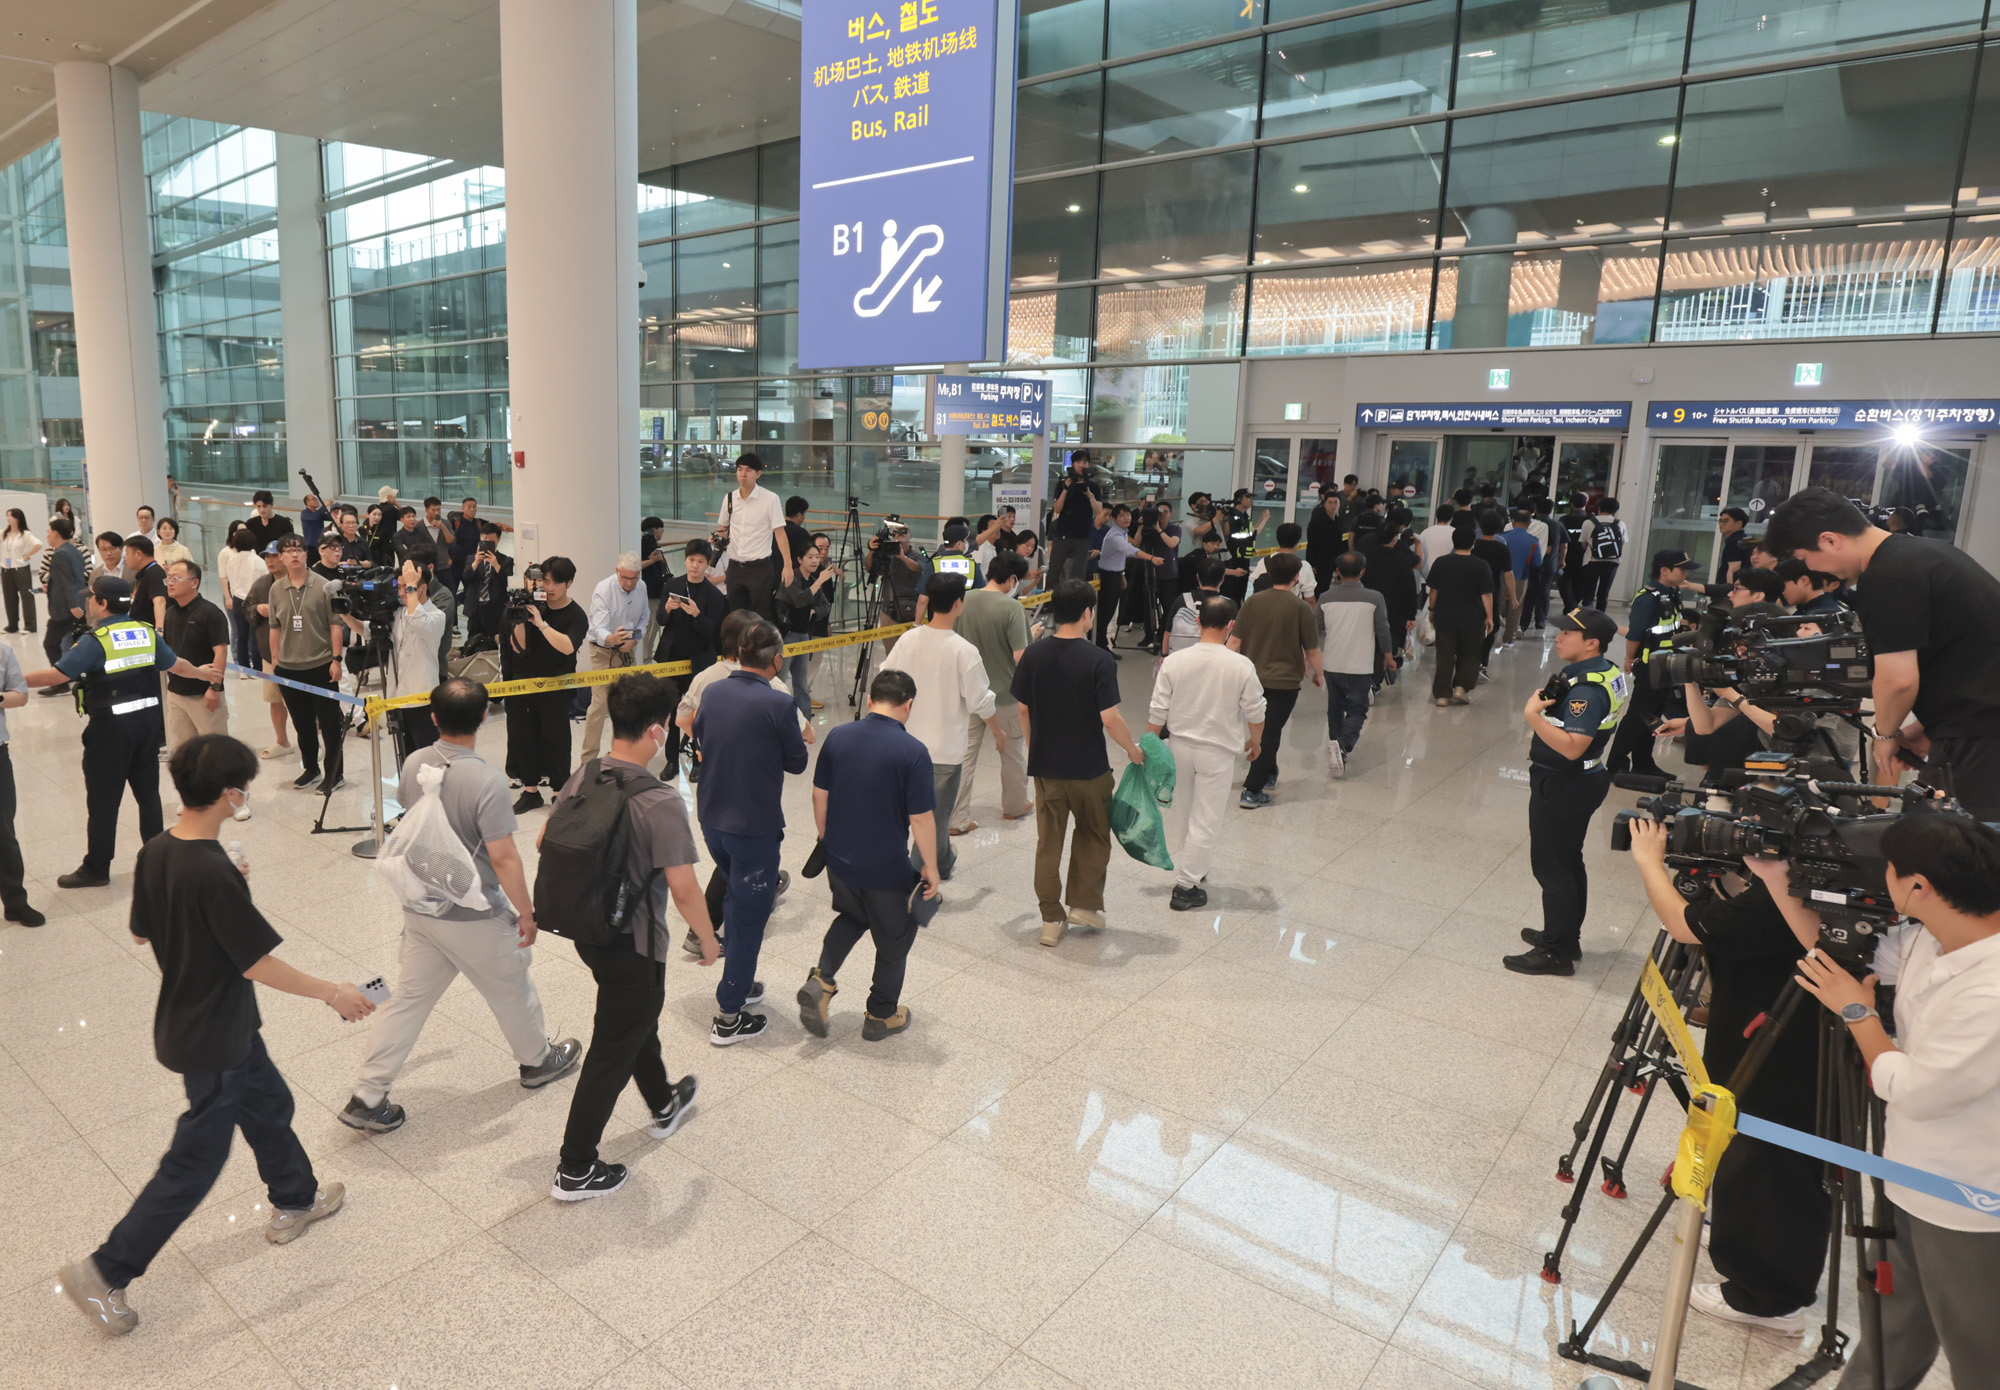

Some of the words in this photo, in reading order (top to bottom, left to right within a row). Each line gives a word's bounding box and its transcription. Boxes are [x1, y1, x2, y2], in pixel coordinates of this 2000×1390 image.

[848, 12, 891, 43] 버스,
[899, 0, 939, 33] 철도
[813, 53, 883, 87] 机场巴士,
[887, 26, 978, 68] 地铁机场线
[853, 82, 889, 108] バス,
[893, 70, 930, 99] 鉄道
[851, 117, 887, 141] Bus,
[894, 104, 929, 132] Rail
[833, 221, 863, 256] B1
[980, 392, 999, 403] Parking
[1000, 385, 1021, 400] 주차장
[936, 412, 947, 425] B1
[1501, 416, 1515, 424] Short
[1565, 416, 1587, 424] Incheon
[1588, 416, 1598, 424] City
[1600, 416, 1610, 424] Bus
[1673, 408, 1686, 423] 9
[1712, 416, 1728, 424] Free
[1728, 416, 1754, 424] Shuttle
[1789, 416, 1807, 424] Term
[1808, 416, 1839, 426] Parking)
[1854, 408, 1996, 422] 순환버스(장기주차장행)
[557, 678, 576, 686] SECURITY
[576, 677, 585, 685] LINE
